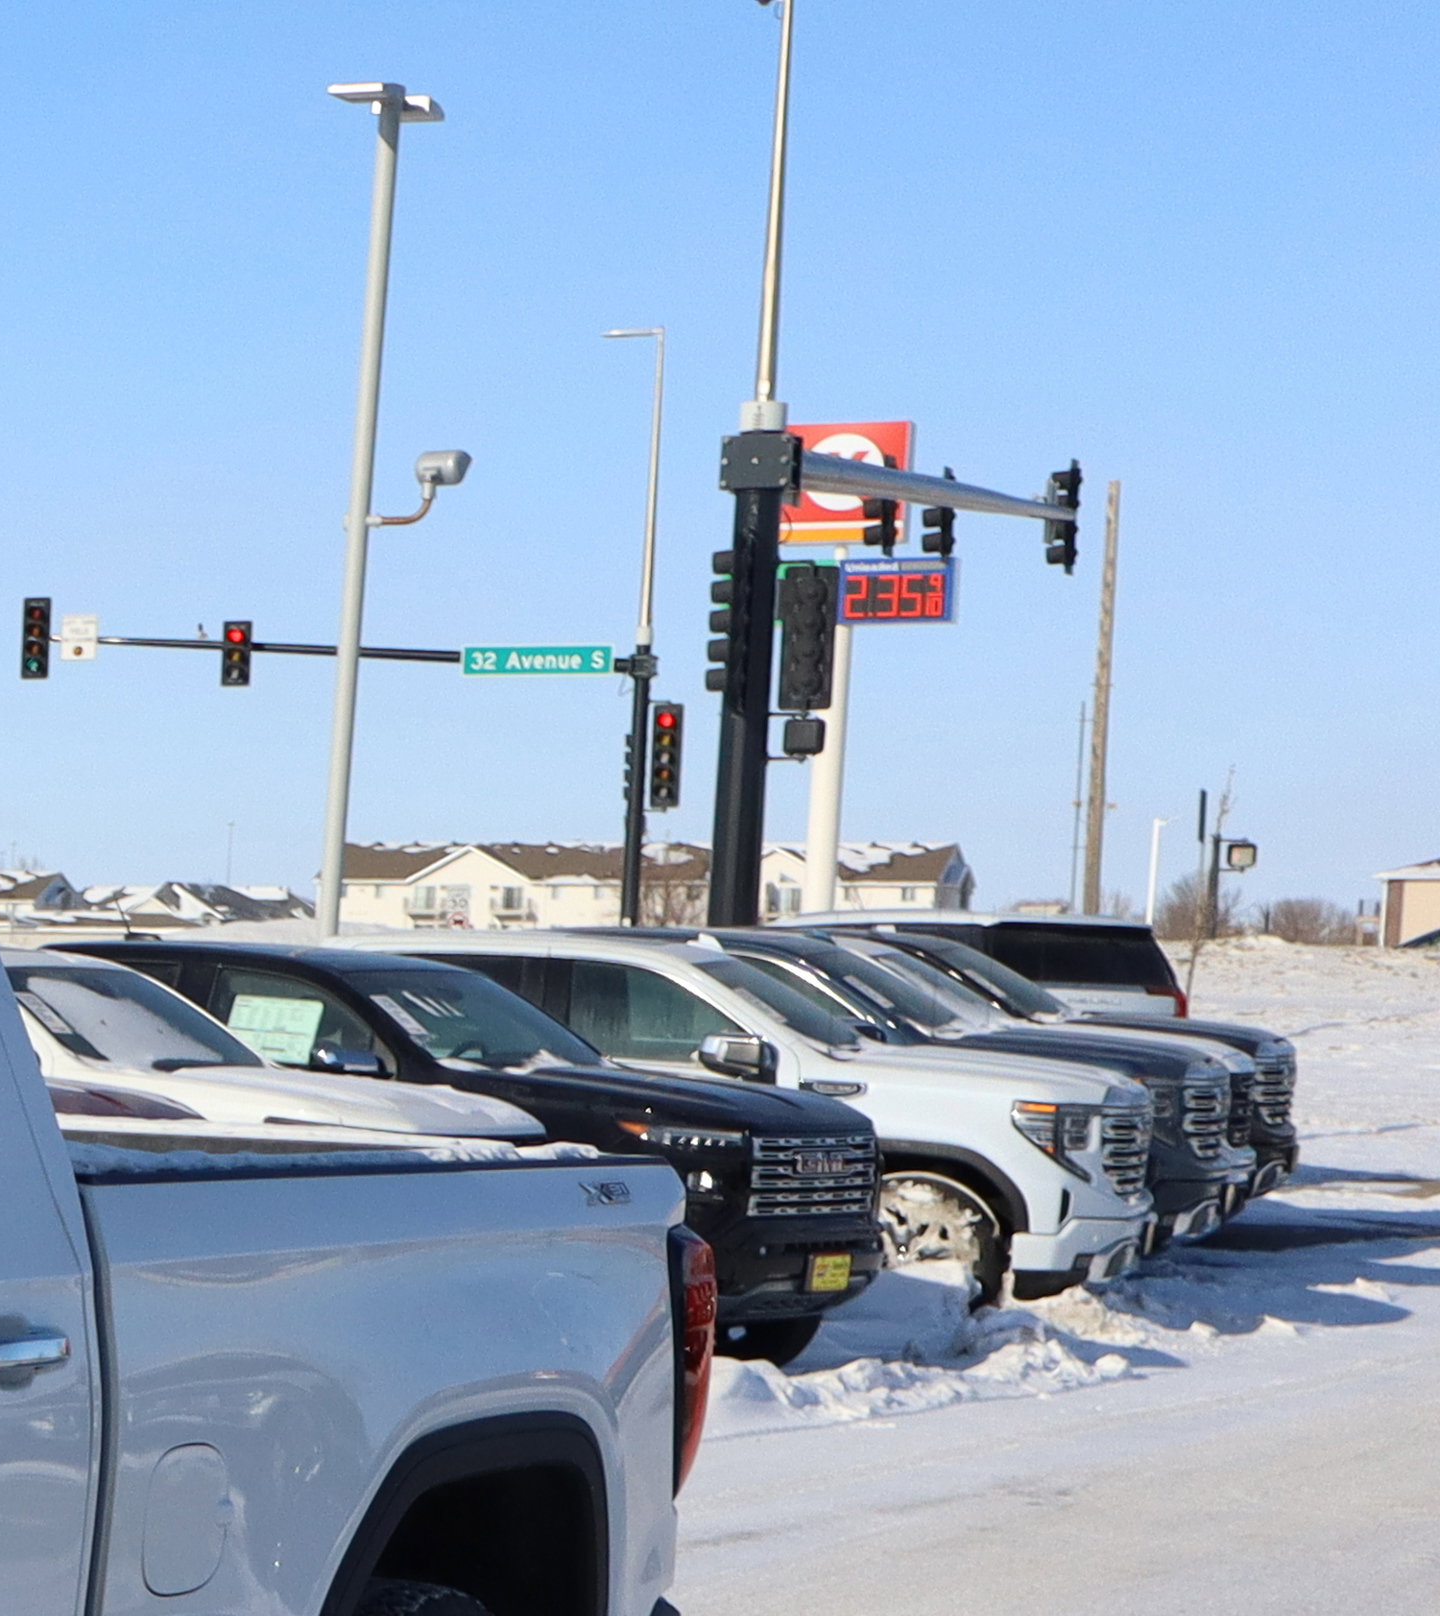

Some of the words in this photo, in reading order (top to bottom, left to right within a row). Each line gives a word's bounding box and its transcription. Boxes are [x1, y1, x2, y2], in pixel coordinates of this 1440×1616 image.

[470, 651, 497, 671] 32
[505, 651, 583, 670] Avenue
[591, 650, 605, 669] S
